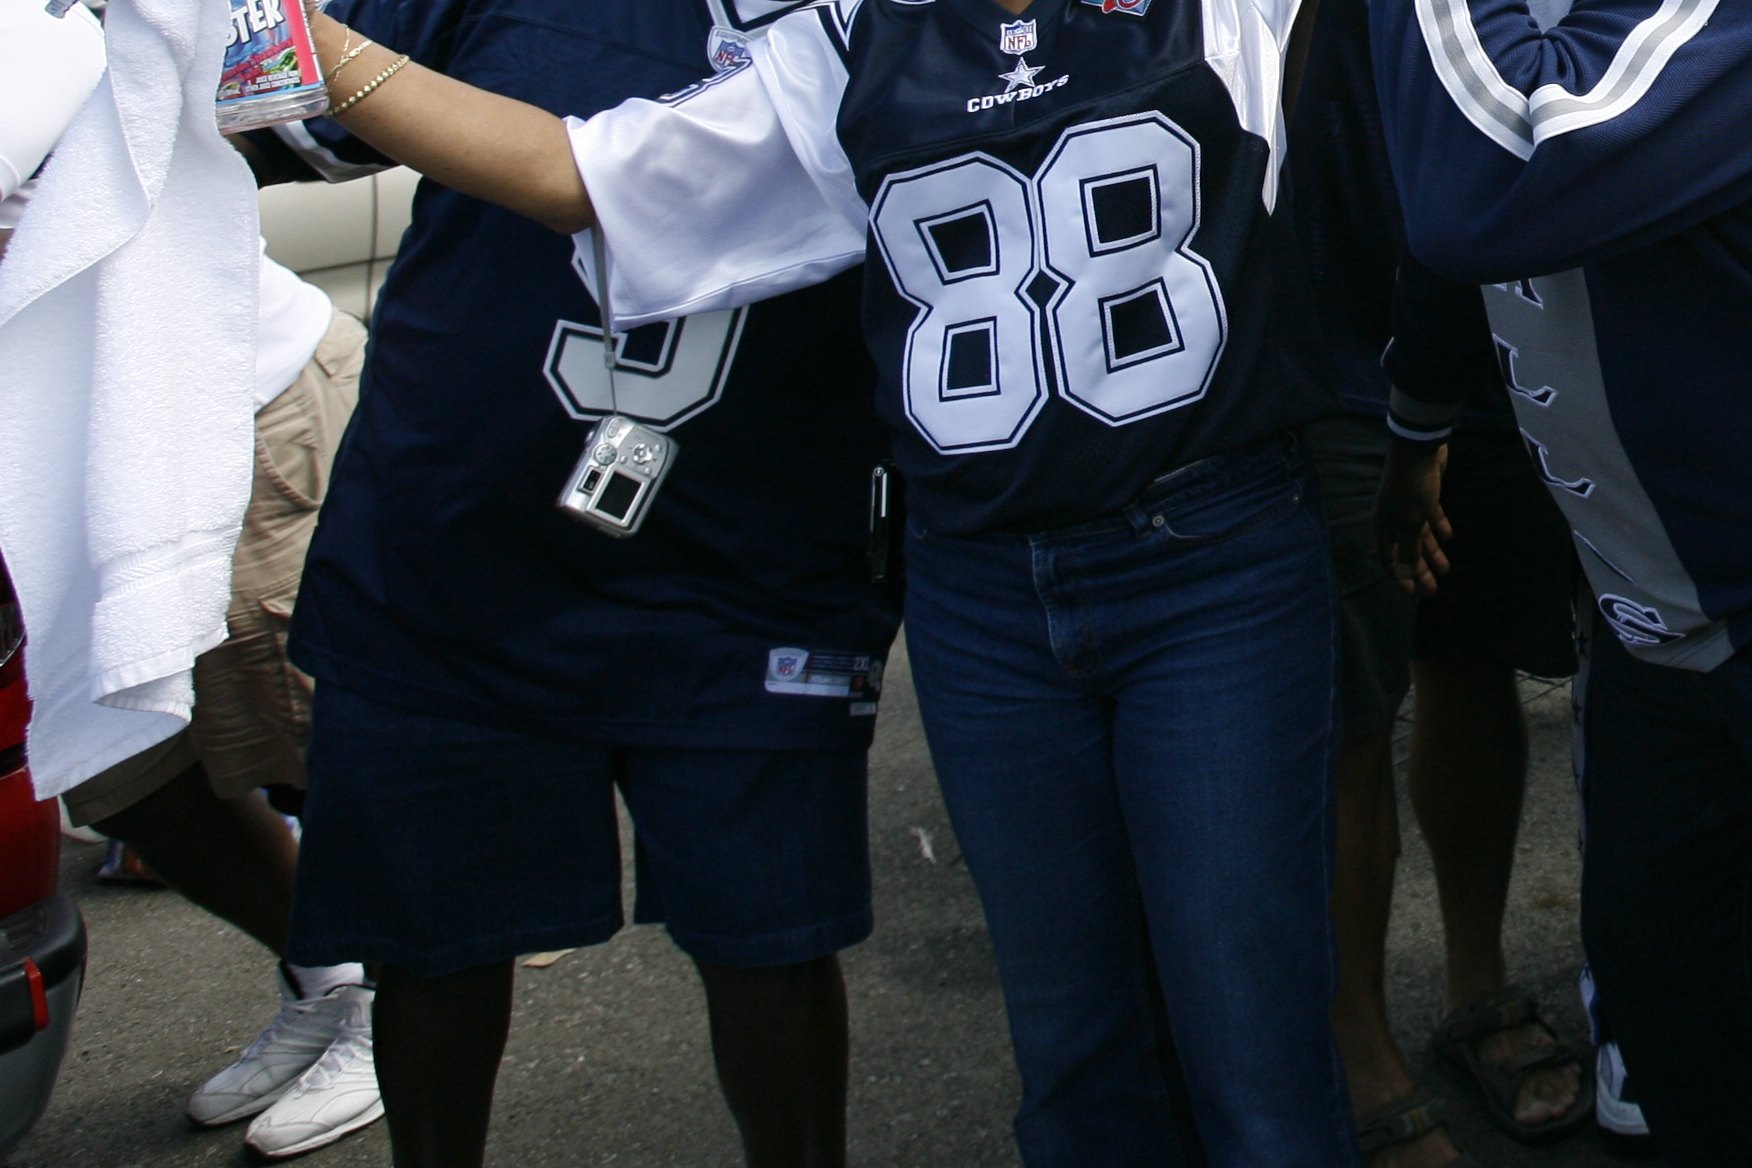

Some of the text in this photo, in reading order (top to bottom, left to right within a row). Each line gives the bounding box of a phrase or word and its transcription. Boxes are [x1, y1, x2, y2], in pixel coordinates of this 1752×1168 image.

[1006, 34, 1032, 51] NFL
[966, 74, 1070, 113] COWBOYS
[868, 109, 1229, 456] 88
